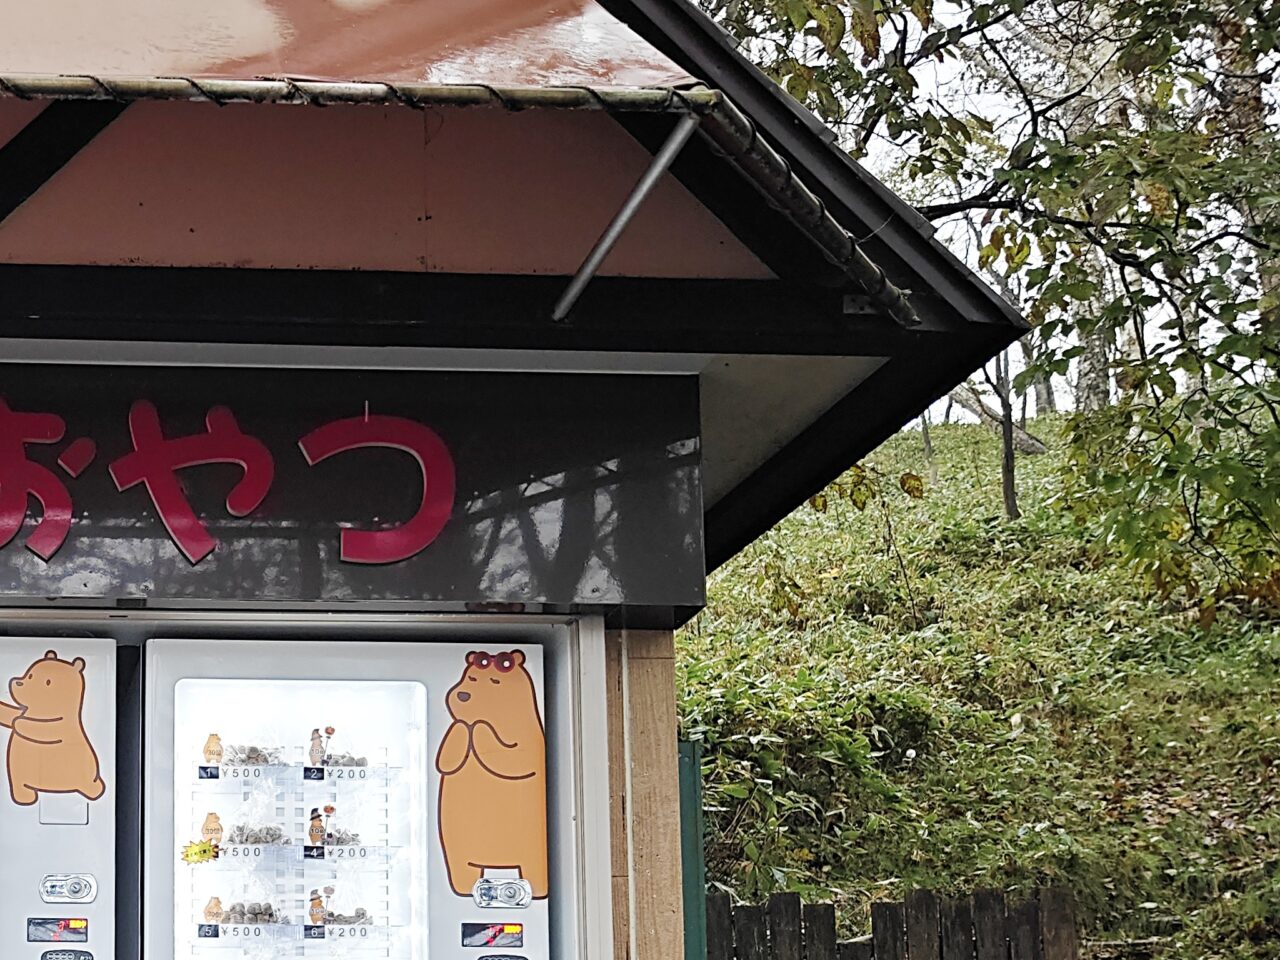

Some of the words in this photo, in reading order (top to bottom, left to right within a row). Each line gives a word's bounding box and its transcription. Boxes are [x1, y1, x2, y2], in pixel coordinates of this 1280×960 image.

[206, 768, 211, 776] 1
[222, 769, 261, 778] ¥500
[311, 769, 317, 778] 2
[327, 769, 366, 778] ¥200
[222, 847, 261, 856] ¥500
[310, 849, 318, 857] 4
[327, 848, 366, 858] ¥200
[222, 927, 261, 937] ¥500
[311, 928, 318, 937] 6
[328, 928, 367, 937] ¥200
